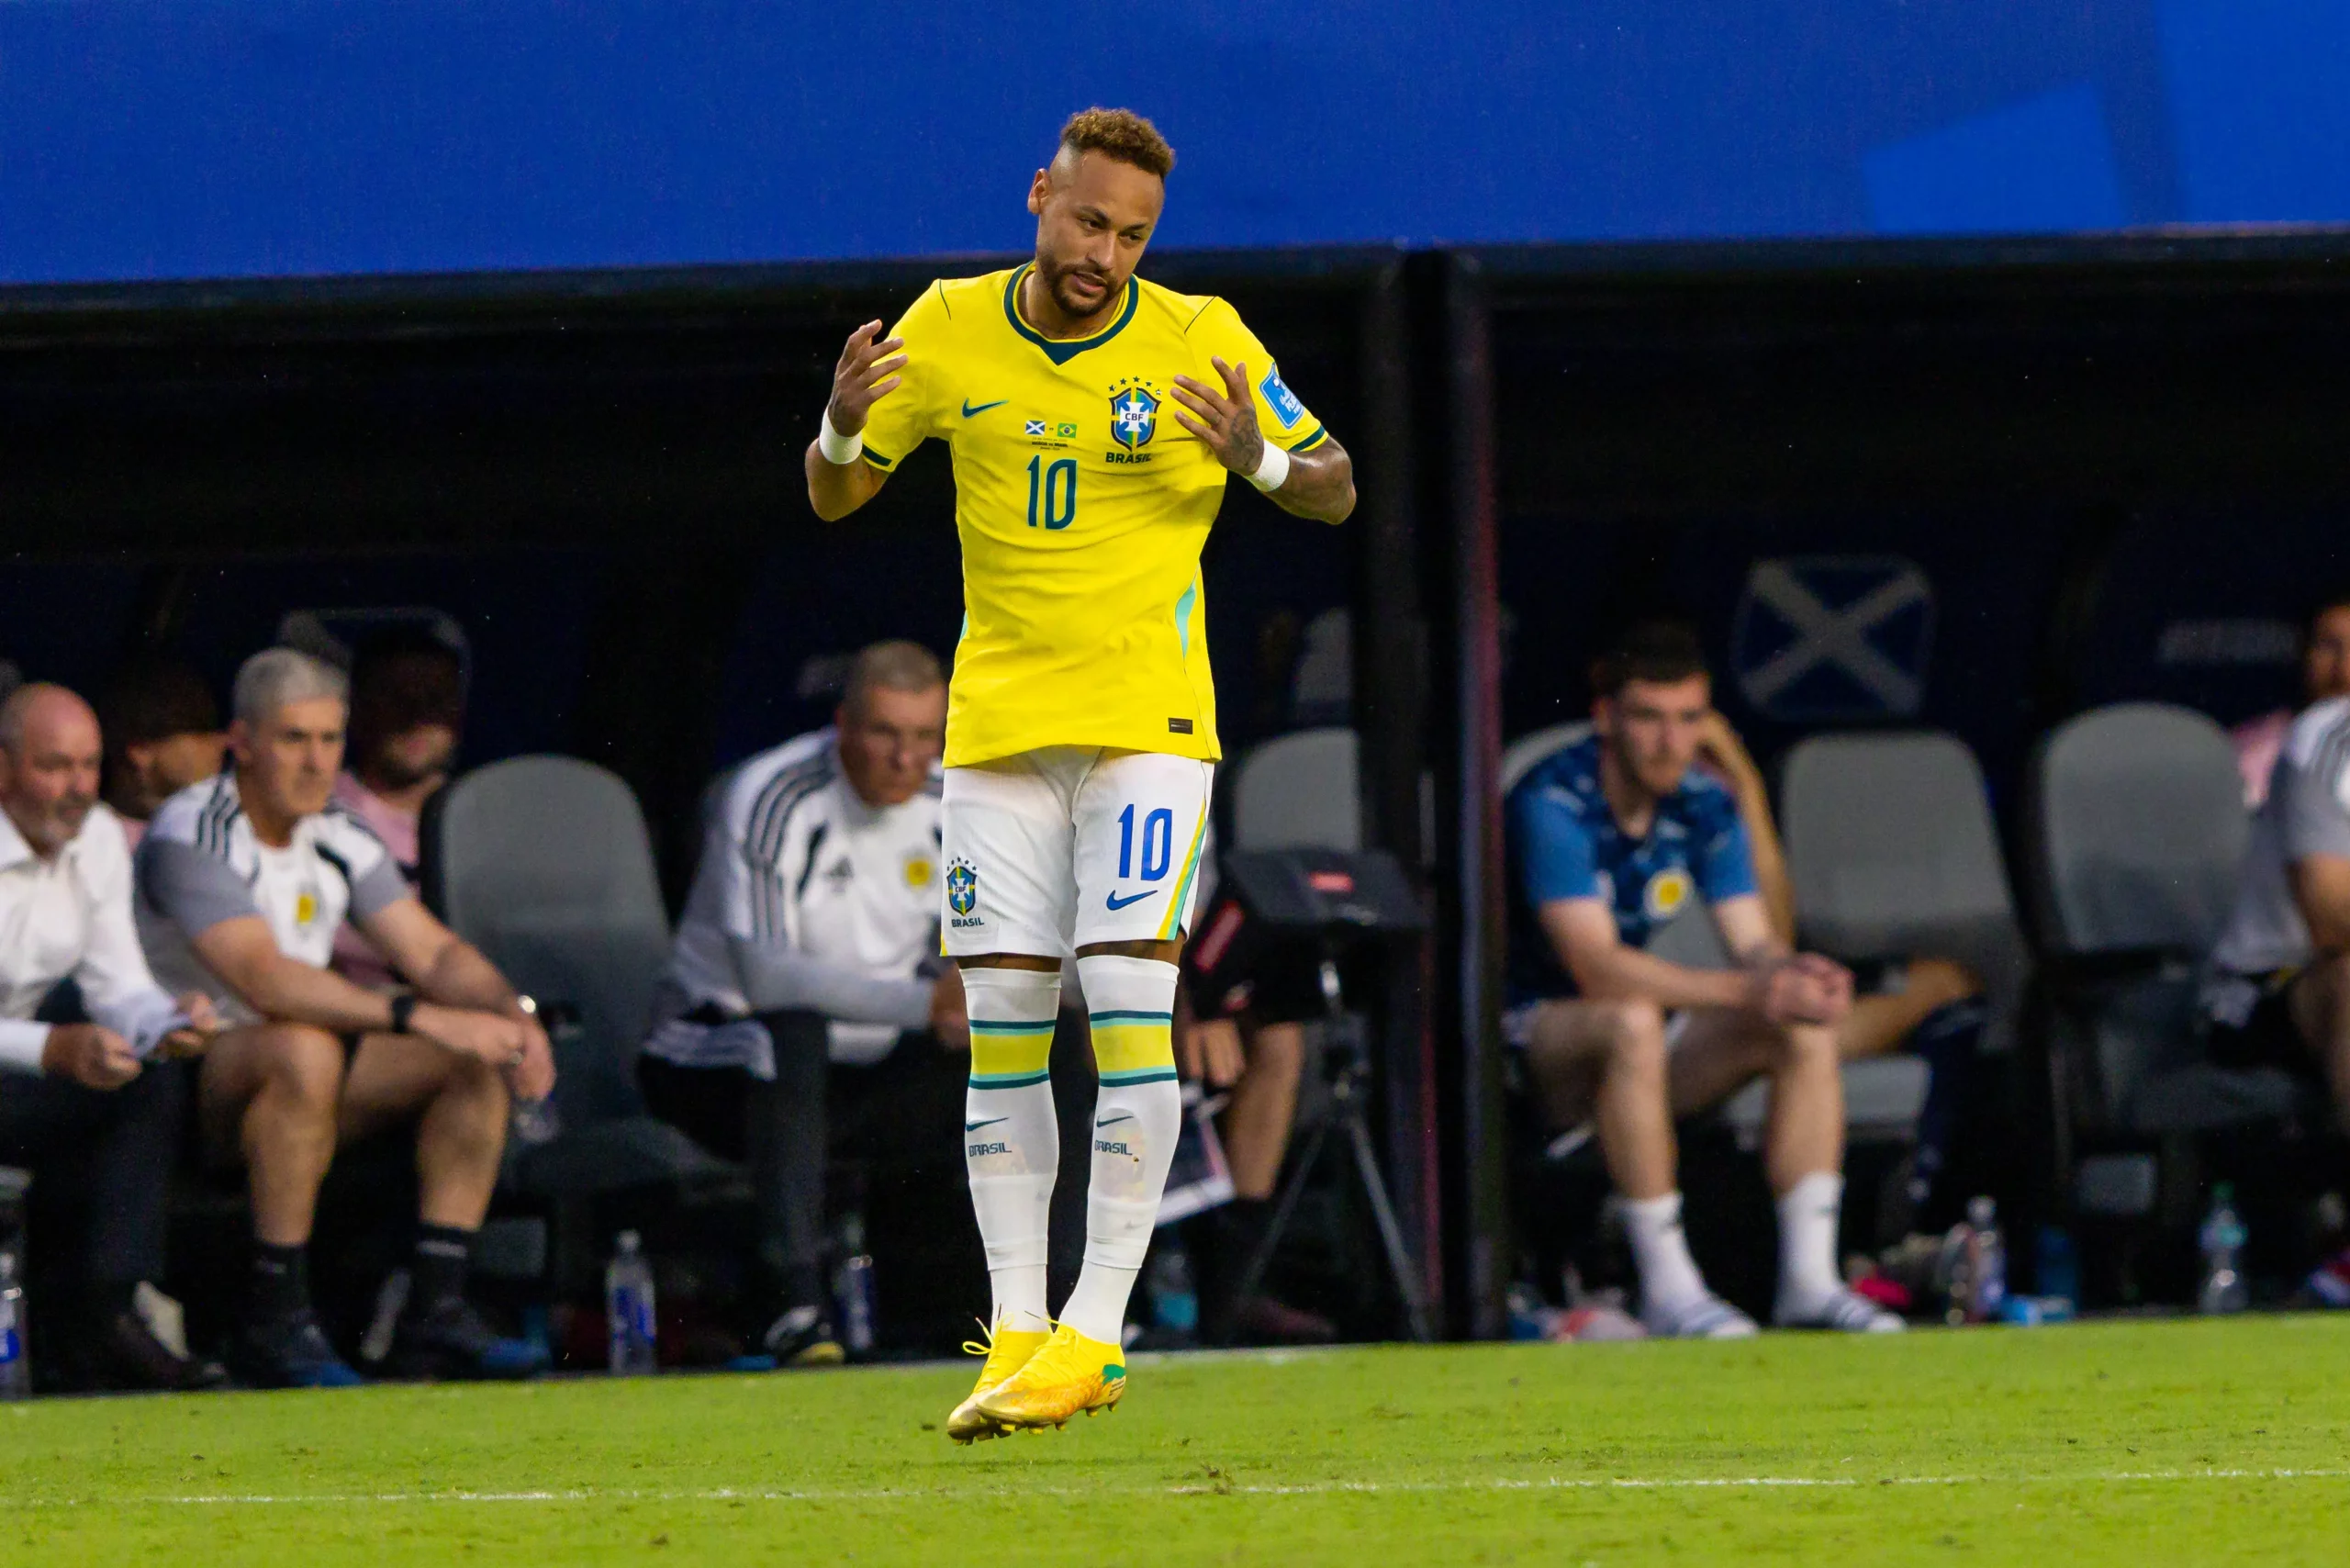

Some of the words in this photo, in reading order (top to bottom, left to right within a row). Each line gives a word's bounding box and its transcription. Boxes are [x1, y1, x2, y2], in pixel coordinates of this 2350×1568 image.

[1125, 412, 1144, 421] CBF
[1105, 452, 1152, 464] BRASIL
[1026, 454, 1077, 531] 10
[1117, 803, 1173, 881] 10
[951, 917, 985, 928] BRASIL
[968, 1142, 1013, 1158] BRASIL
[1094, 1139, 1134, 1156] BRASIL
